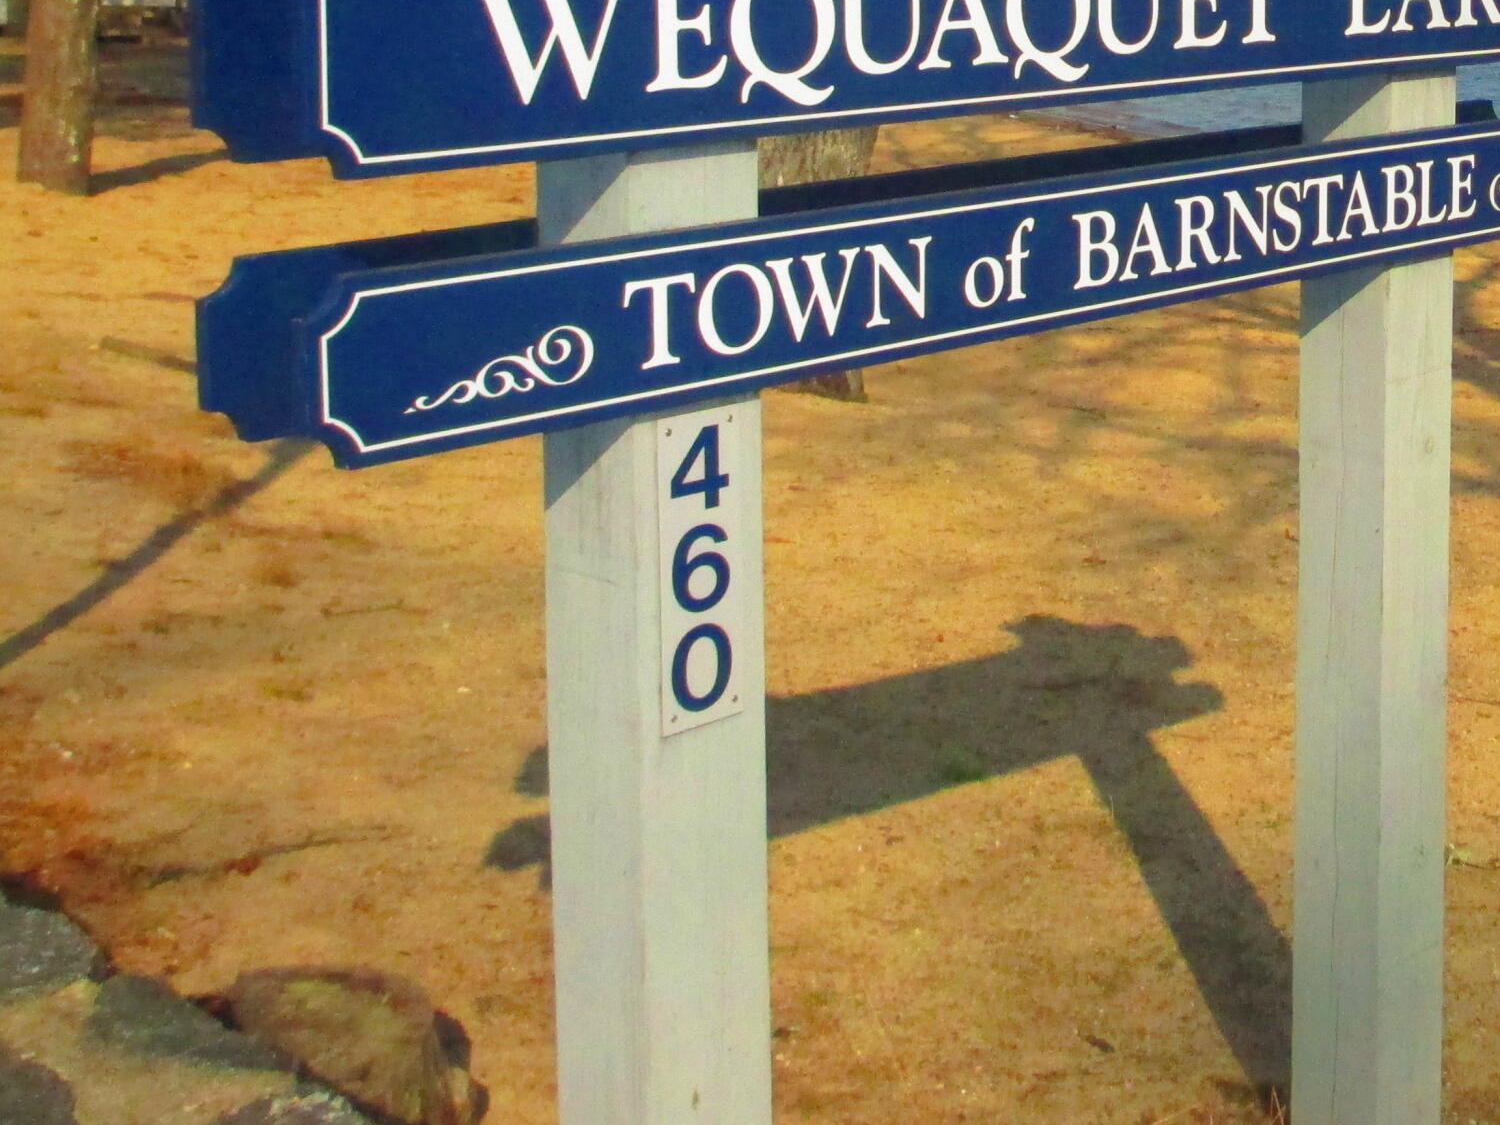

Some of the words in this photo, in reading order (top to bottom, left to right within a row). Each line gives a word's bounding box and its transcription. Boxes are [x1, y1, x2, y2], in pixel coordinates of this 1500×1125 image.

[622, 235, 933, 370] TOWN
[963, 216, 1035, 308] of
[1071, 154, 1477, 291] BARNSTABLE
[670, 423, 733, 713] 460
